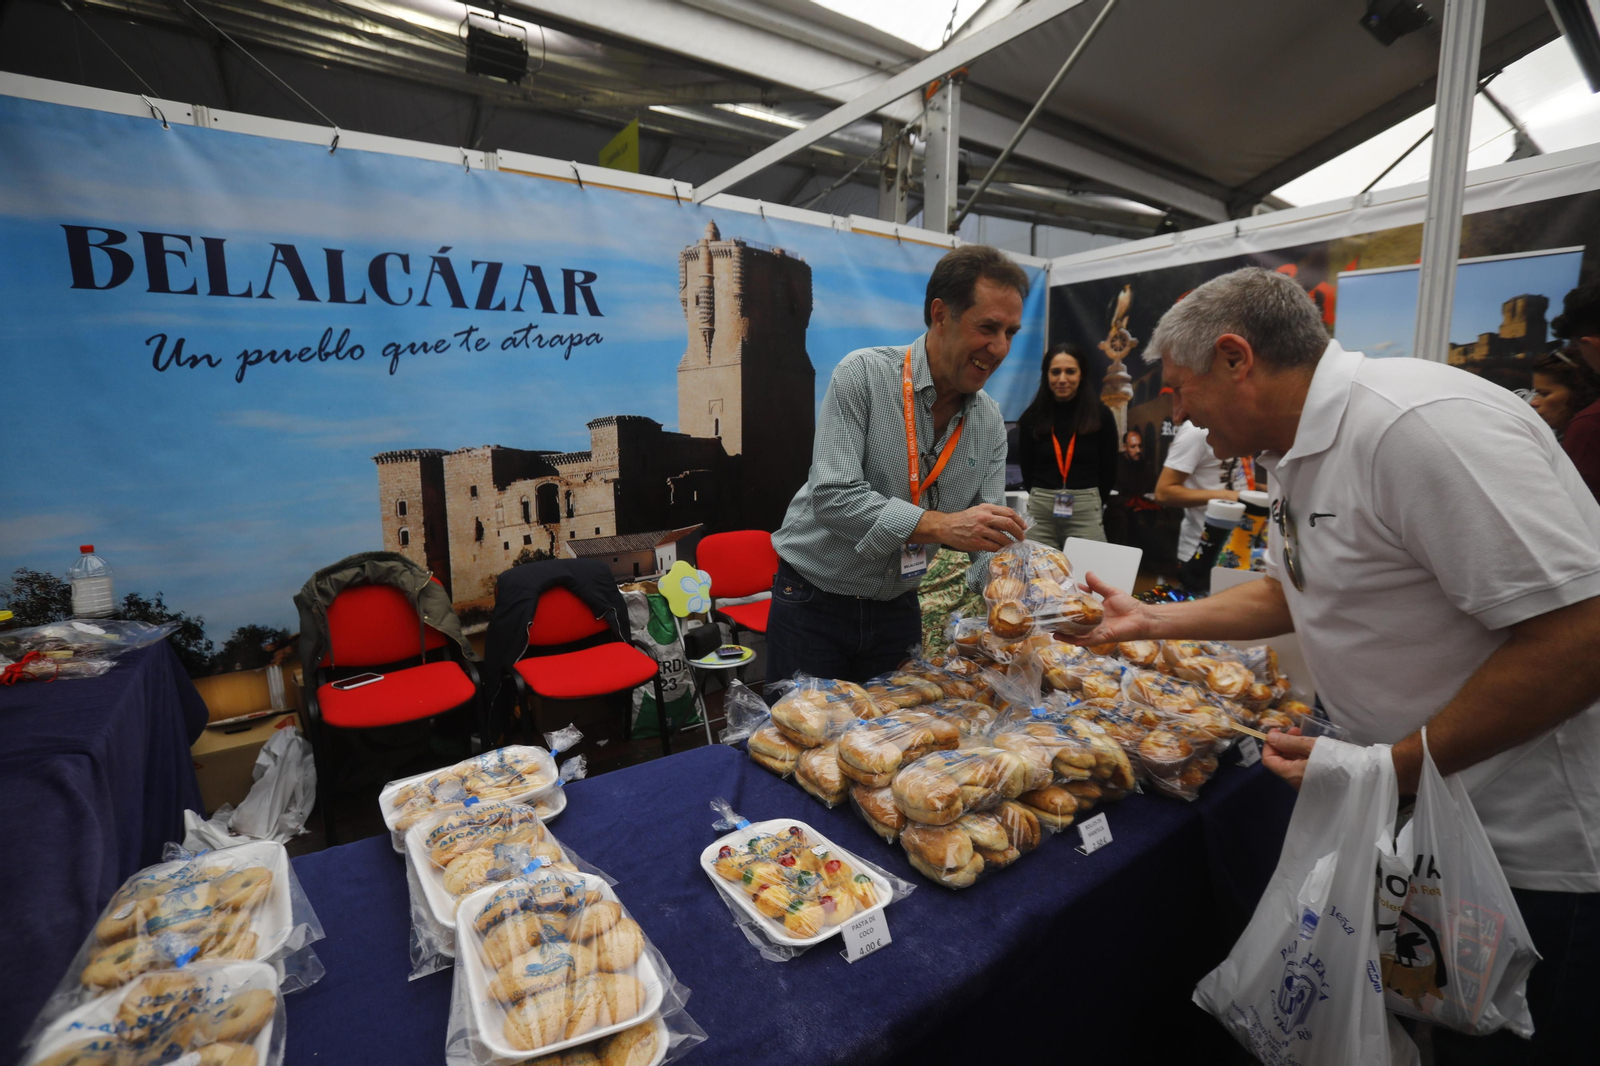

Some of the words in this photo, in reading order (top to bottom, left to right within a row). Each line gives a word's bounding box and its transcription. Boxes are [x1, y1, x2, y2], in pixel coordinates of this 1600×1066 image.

[59, 223, 605, 318] BELALCÁZAR
[144, 332, 222, 373] Un
[234, 325, 366, 384] pueblo
[381, 338, 452, 376] que
[453, 324, 491, 353] te
[500, 322, 604, 361] atrapa
[851, 918, 869, 932] PASTA
[868, 914, 877, 923] DE
[858, 926, 875, 939] COCO
[1329, 905, 1356, 936] leña
[859, 941, 876, 956] 4.00
[876, 937, 882, 947] €
